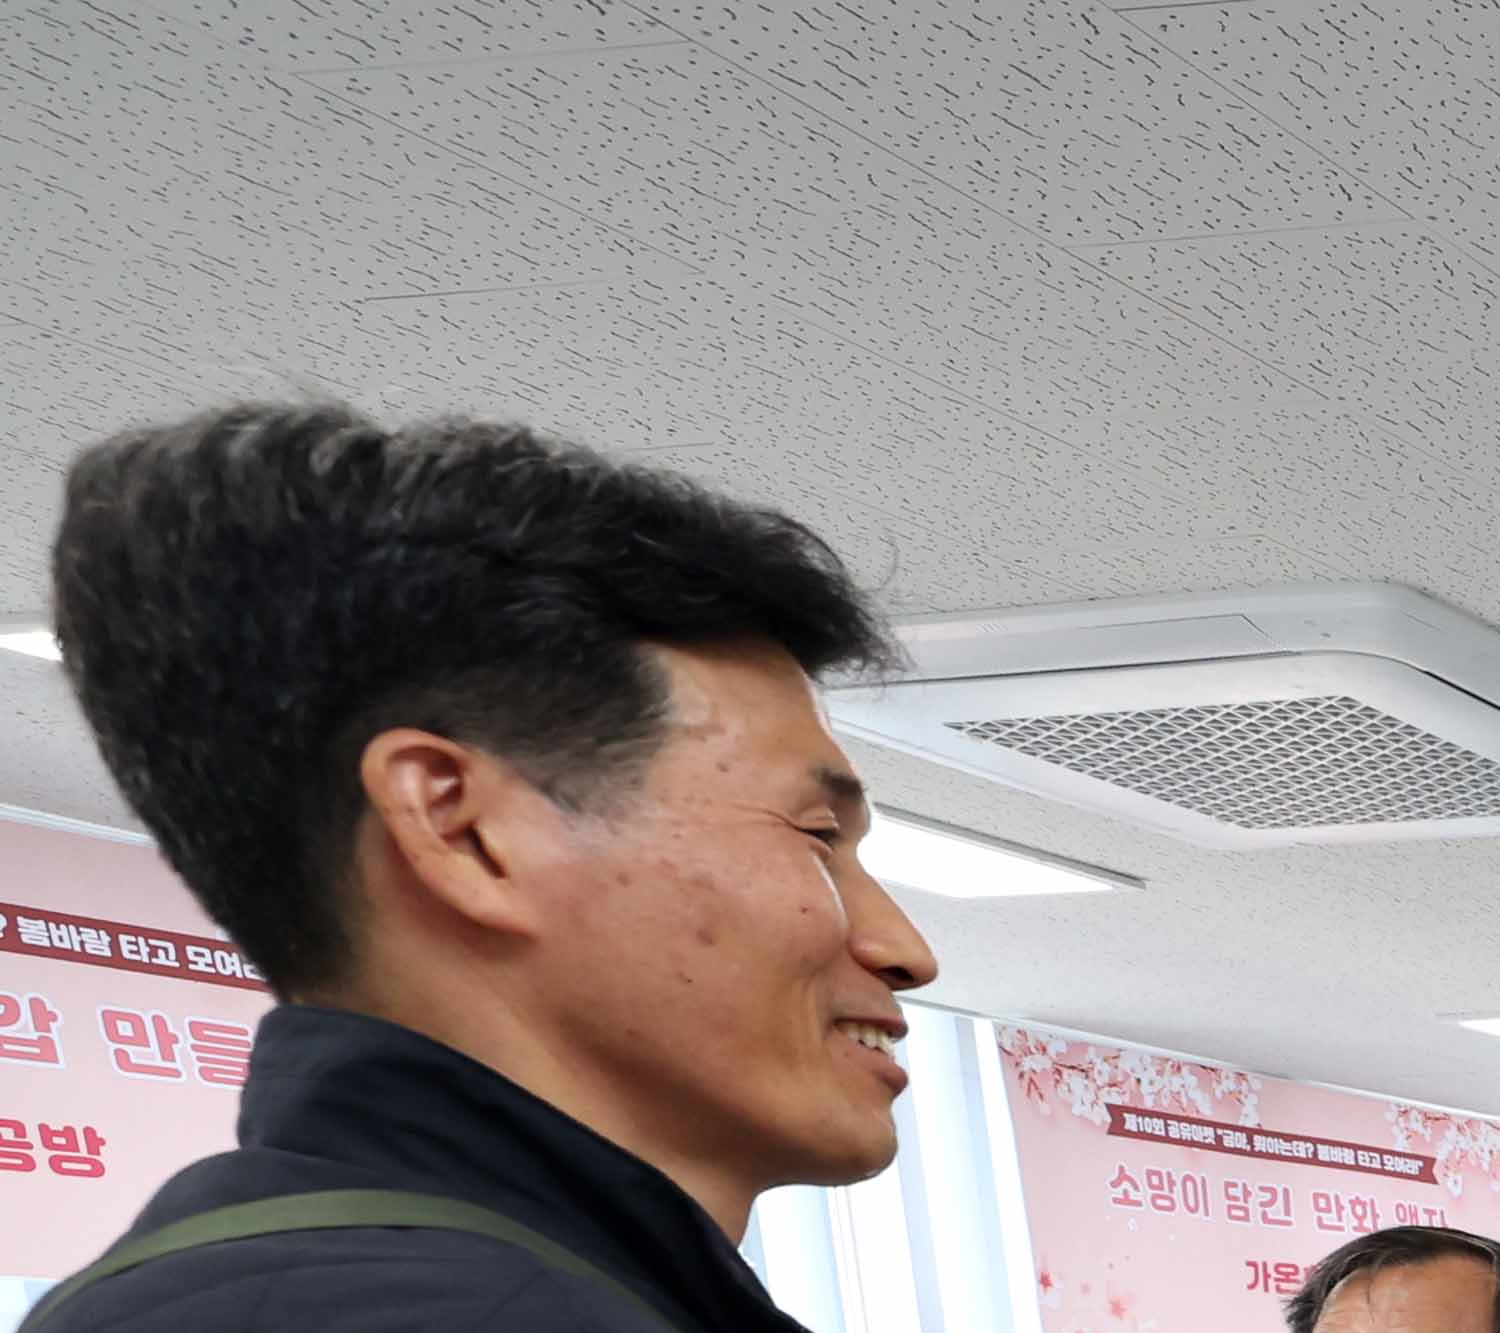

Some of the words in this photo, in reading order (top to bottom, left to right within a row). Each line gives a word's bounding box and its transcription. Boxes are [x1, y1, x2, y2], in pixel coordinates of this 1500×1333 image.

[16, 915, 112, 957] 봄바람
[119, 934, 180, 968] 타고
[1110, 1165, 1211, 1217] 소망이
[1224, 1180, 1293, 1226] 담긴
[1312, 1191, 1380, 1233] 만화
[1246, 1260, 1322, 1296] 가온
